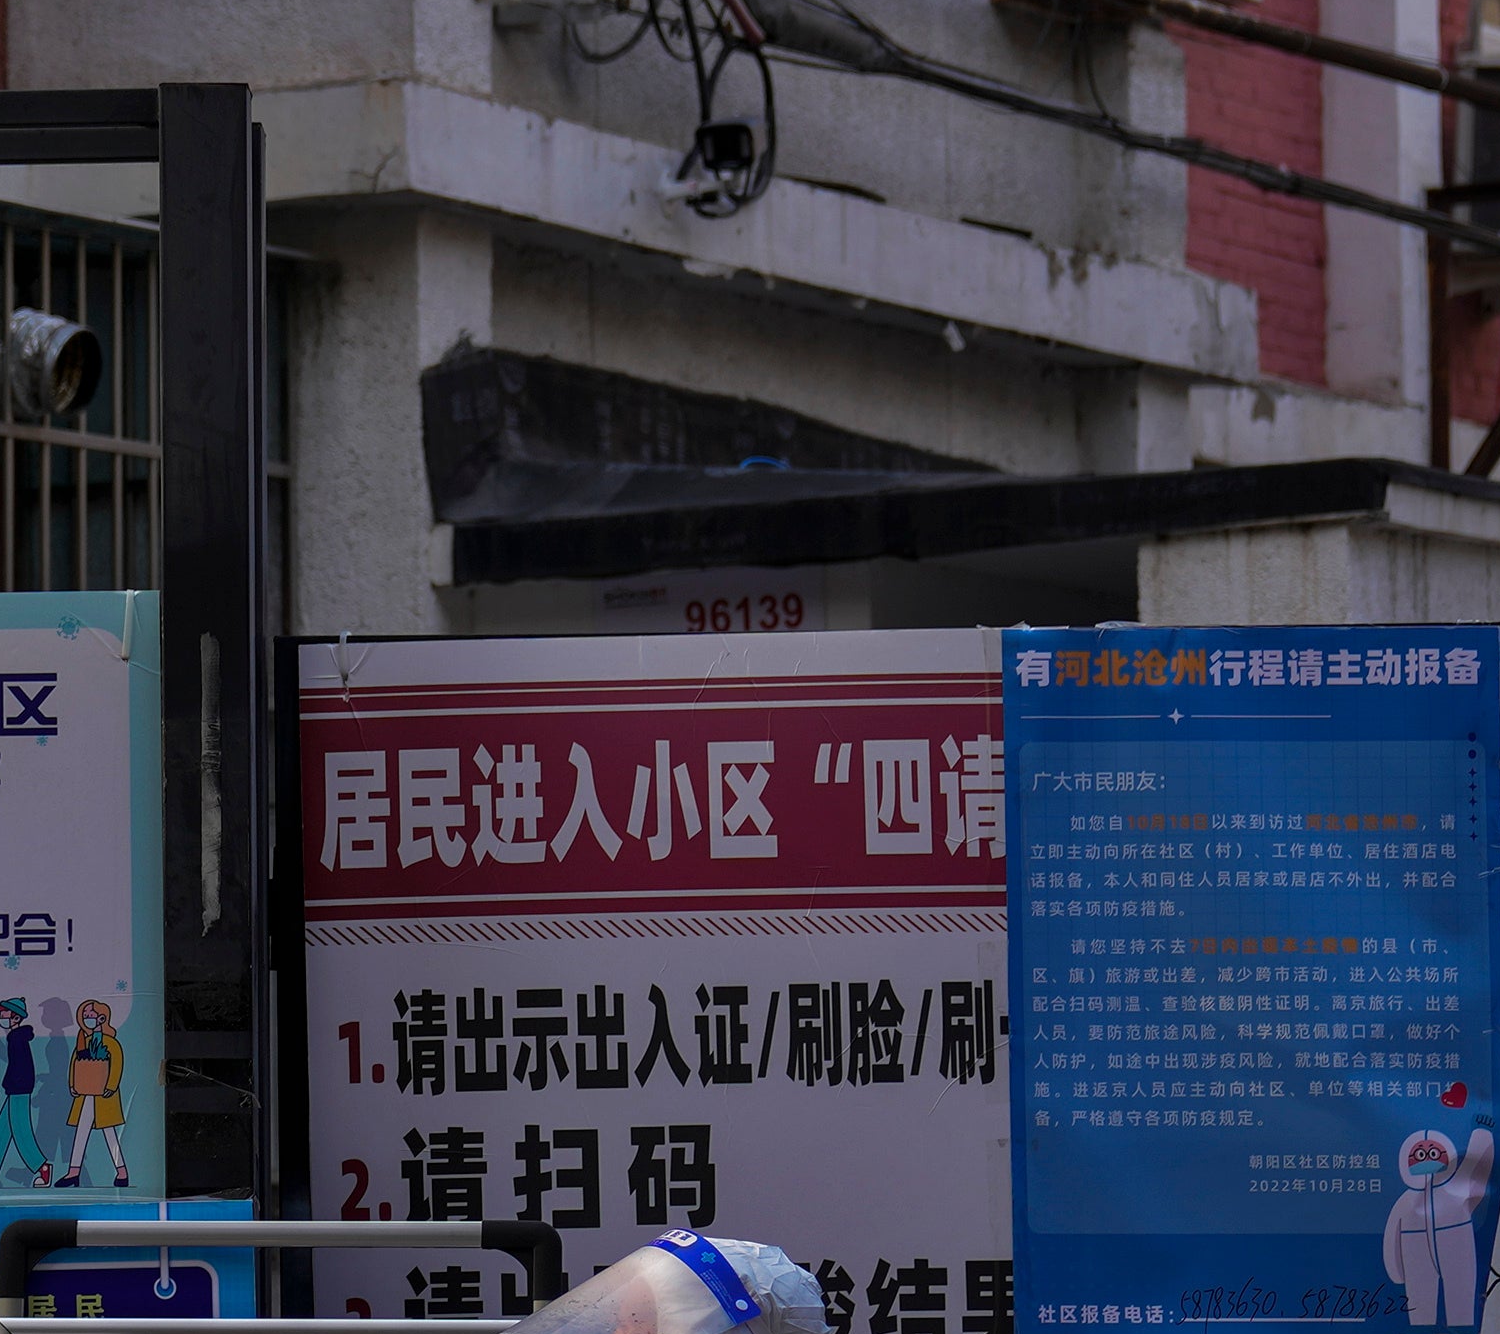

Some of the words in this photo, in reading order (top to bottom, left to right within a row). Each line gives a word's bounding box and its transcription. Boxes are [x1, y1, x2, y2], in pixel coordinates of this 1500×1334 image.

[684, 593, 804, 633] 96139
[1015, 647, 1482, 688] 有河北沧州行程请主动报备
[1032, 771, 1167, 793] 广大市民朋友：
[1031, 899, 1187, 918] 落实各项防疫措施。
[337, 978, 1009, 1098] 1.请出示出入证/刷脸/刷
[1248, 1153, 1382, 1170] 朝阳区社区防控组
[1248, 1178, 1382, 1195] 2022年10月28日
